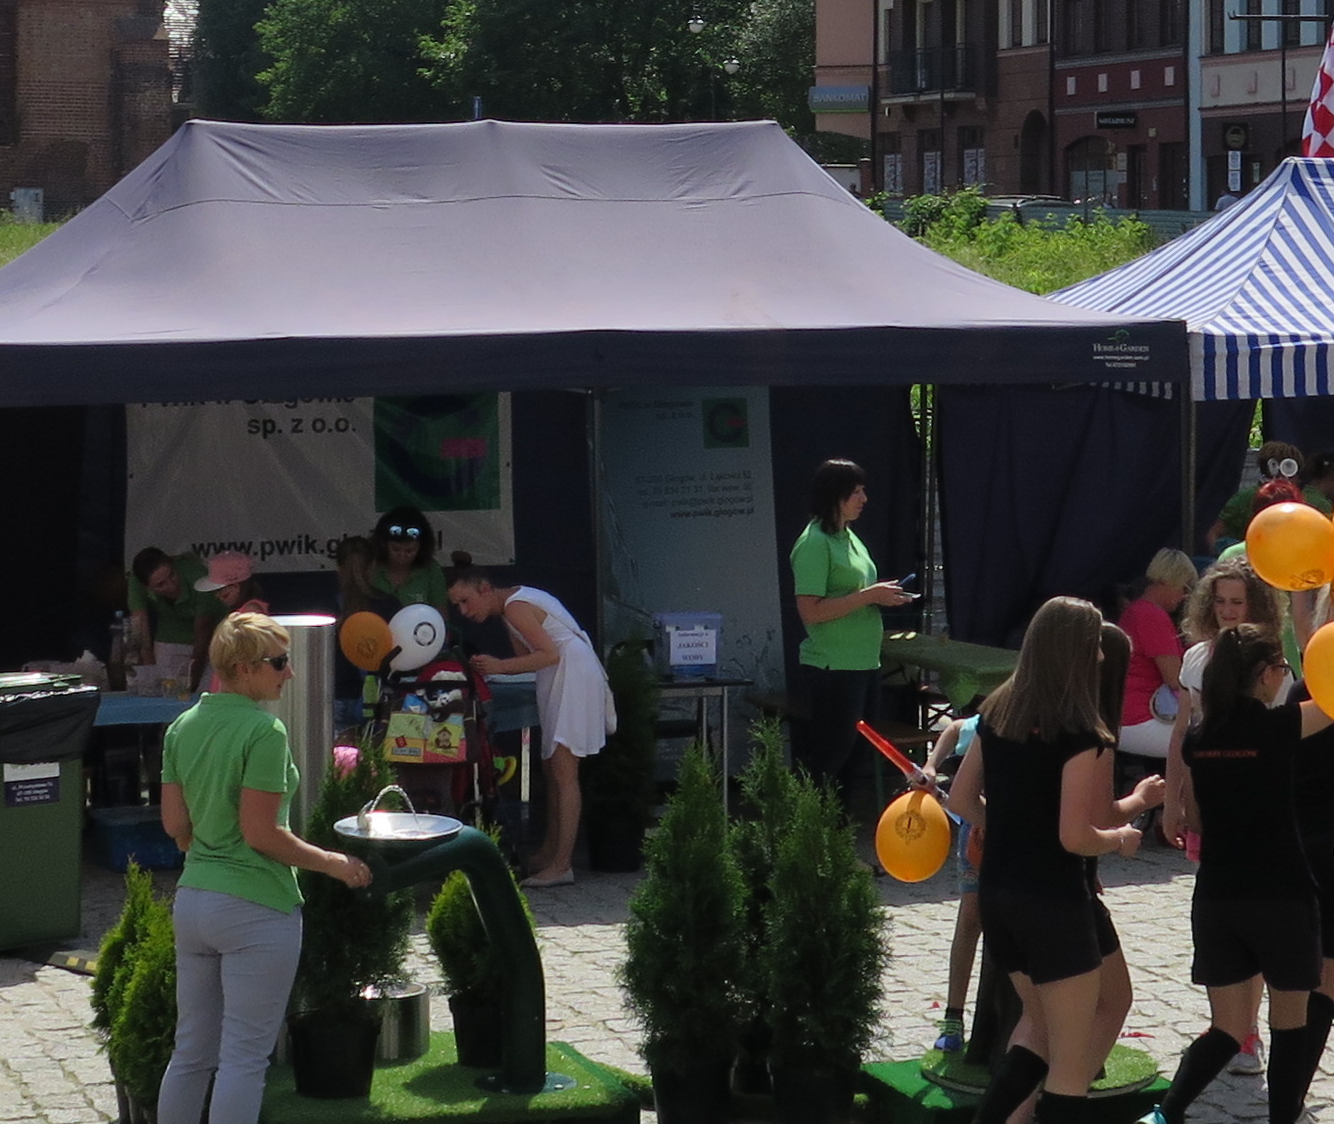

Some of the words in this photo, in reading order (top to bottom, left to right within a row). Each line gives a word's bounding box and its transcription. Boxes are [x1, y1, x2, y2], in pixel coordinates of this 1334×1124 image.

[247, 419, 283, 439] sp.
[291, 419, 304, 434] z
[312, 417, 357, 434] o.o.
